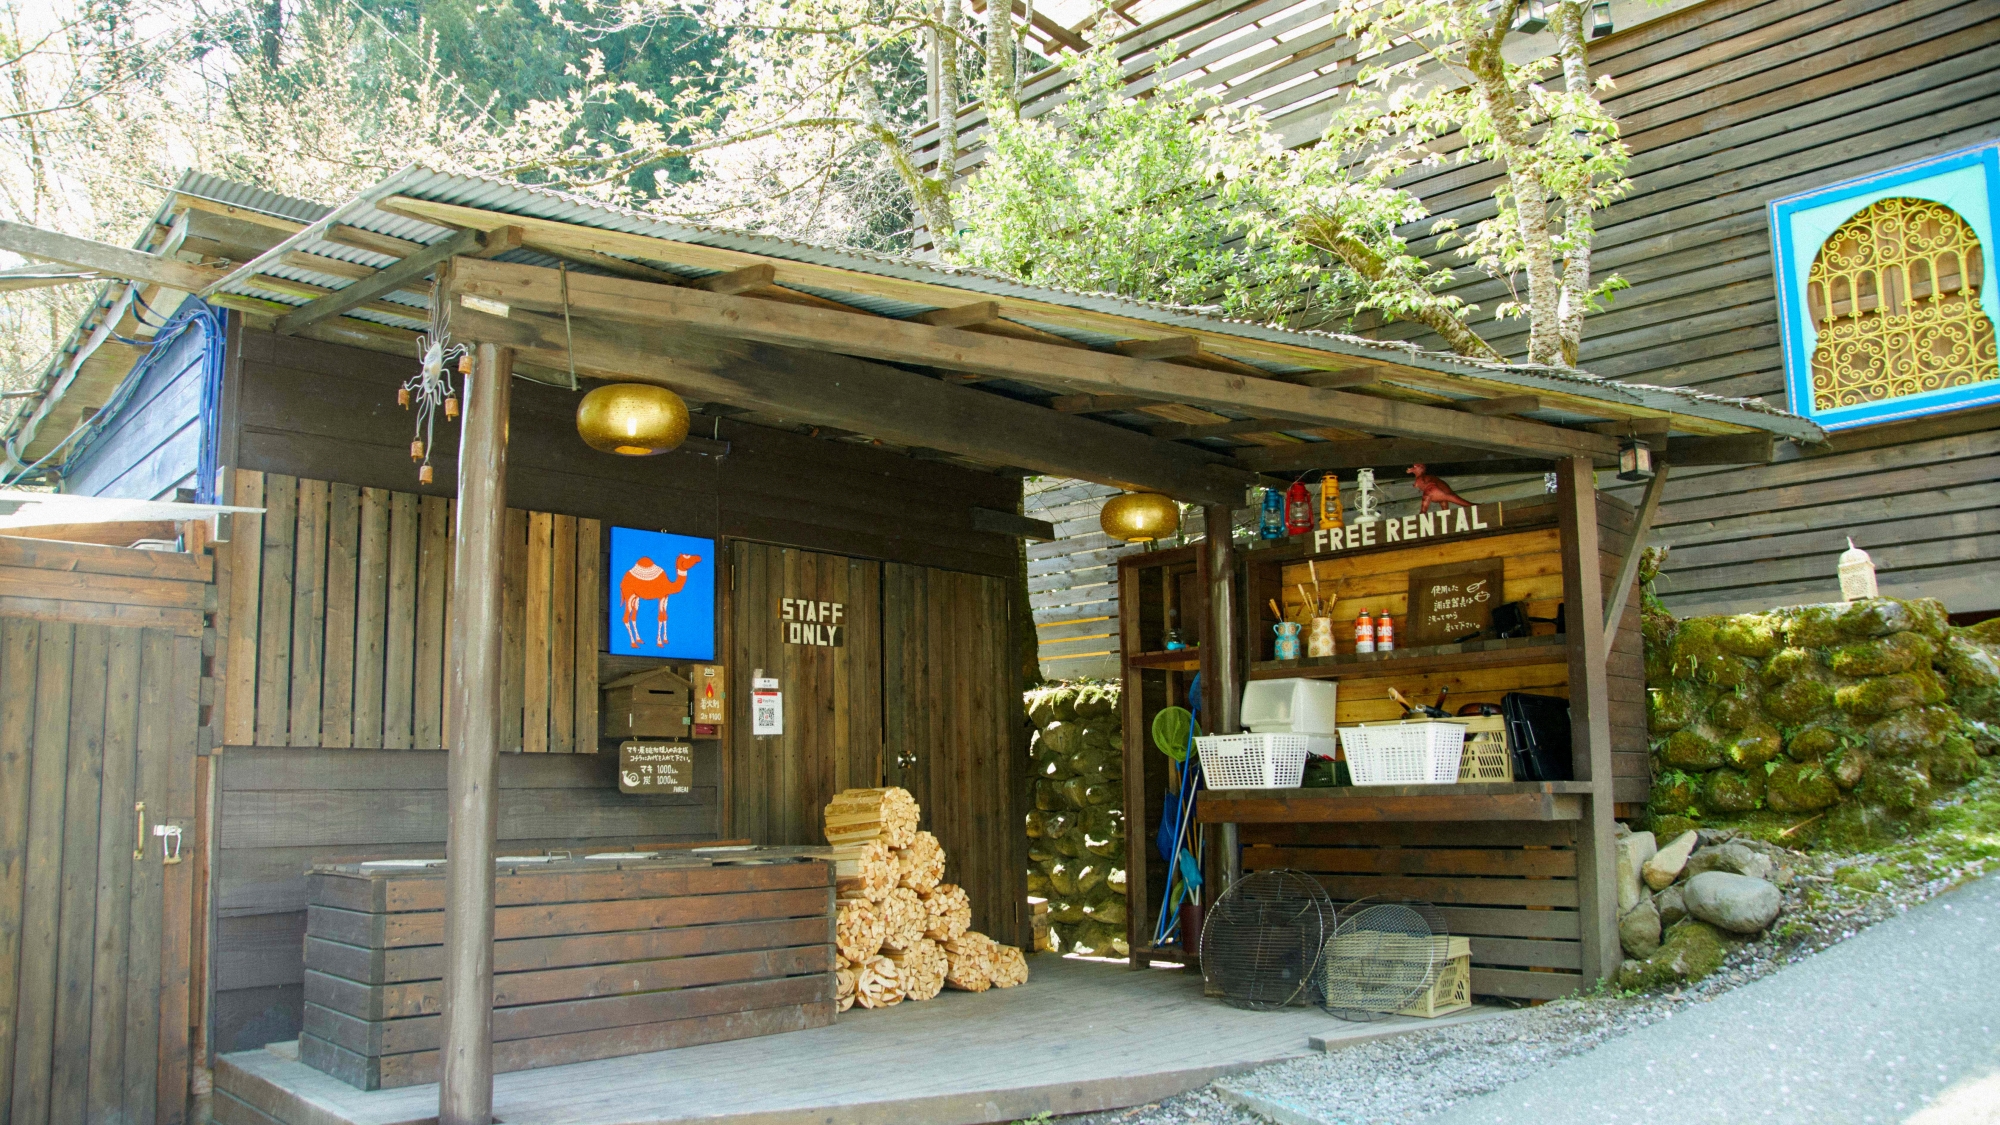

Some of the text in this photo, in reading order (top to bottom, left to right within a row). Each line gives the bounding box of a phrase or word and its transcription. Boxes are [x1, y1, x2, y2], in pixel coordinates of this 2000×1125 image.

[1314, 505, 1488, 553] FREE RENTAL
[782, 598, 843, 623] STAFF
[790, 622, 837, 647] ONLY
[1357, 625, 1373, 636] GAS
[1377, 626, 1392, 637] GAS
[640, 764, 653, 774] マキ
